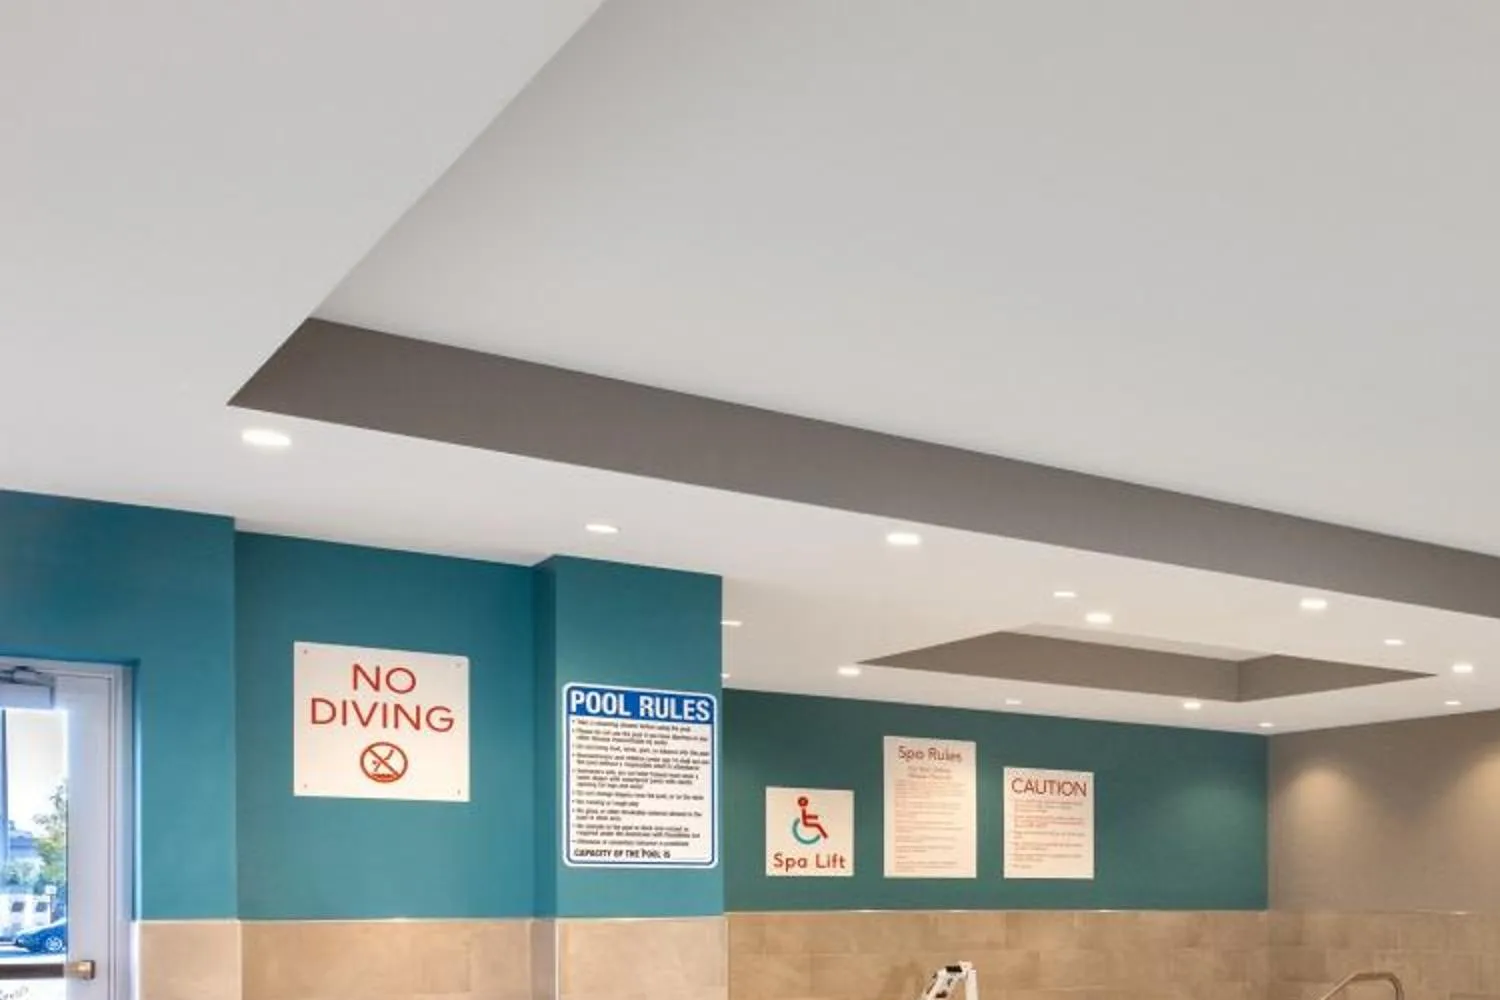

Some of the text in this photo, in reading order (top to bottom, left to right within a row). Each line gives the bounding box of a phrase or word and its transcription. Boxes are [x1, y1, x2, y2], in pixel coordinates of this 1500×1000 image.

[352, 663, 417, 694] NO
[311, 698, 455, 733] DIVING
[570, 690, 710, 721] POOL RULES
[899, 745, 962, 763] Spa Rules
[1011, 777, 1087, 797] CAUTION
[574, 848, 611, 857] CAPACITY
[626, 849, 640, 858] THE
[642, 849, 660, 858] POOL
[773, 853, 846, 872] Spa Lift
